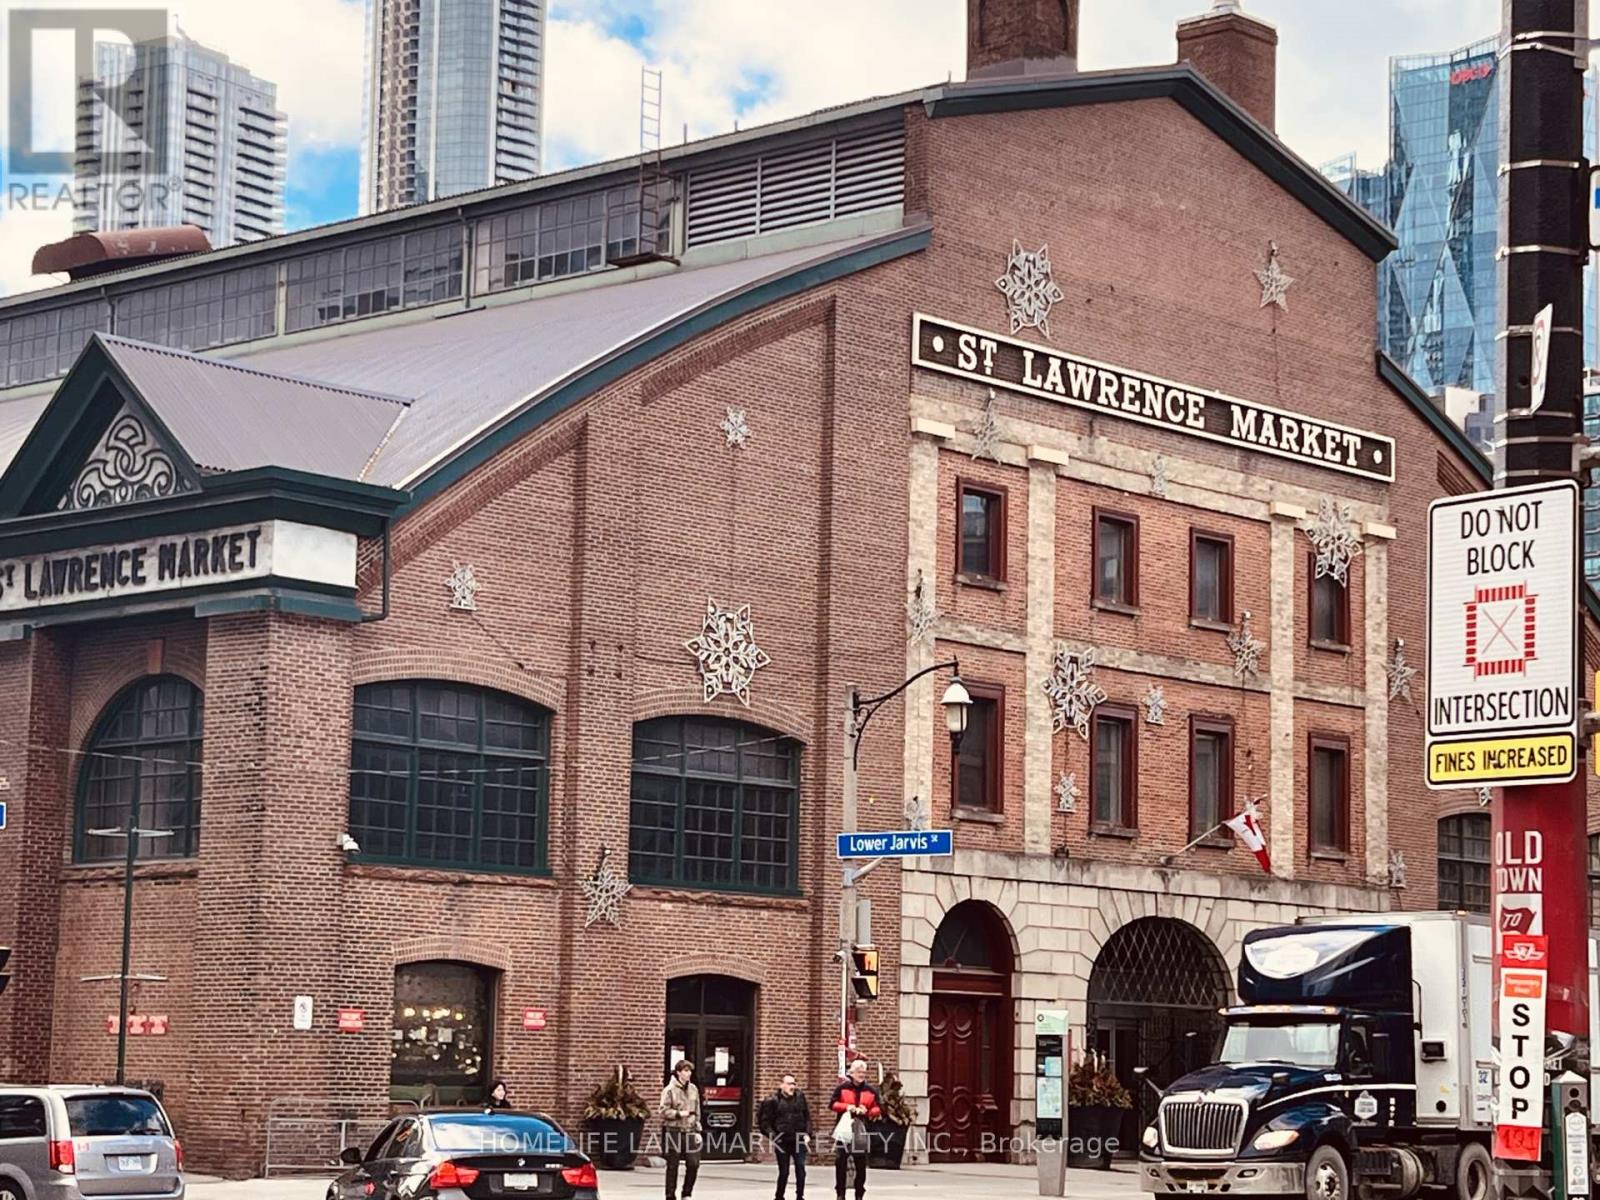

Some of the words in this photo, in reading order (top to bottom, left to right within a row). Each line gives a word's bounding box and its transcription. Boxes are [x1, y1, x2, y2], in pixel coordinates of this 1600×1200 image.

[957, 333, 998, 375] ST
[1022, 349, 1206, 429] LAWRENCE
[1230, 404, 1362, 466] MARKET
[1460, 508, 1491, 539] DO
[1497, 500, 1543, 534] NOT
[24, 546, 148, 600] LAWRENCE
[158, 527, 262, 581] MARKET
[1466, 539, 1535, 576] BLOCK
[1434, 686, 1569, 725] INTERSECTION
[1435, 751, 1476, 773] FINES
[1482, 745, 1567, 770] INCREASED
[850, 836, 888, 852] Lower
[889, 834, 928, 851] Jarvis
[1502, 912, 1523, 929] TO
